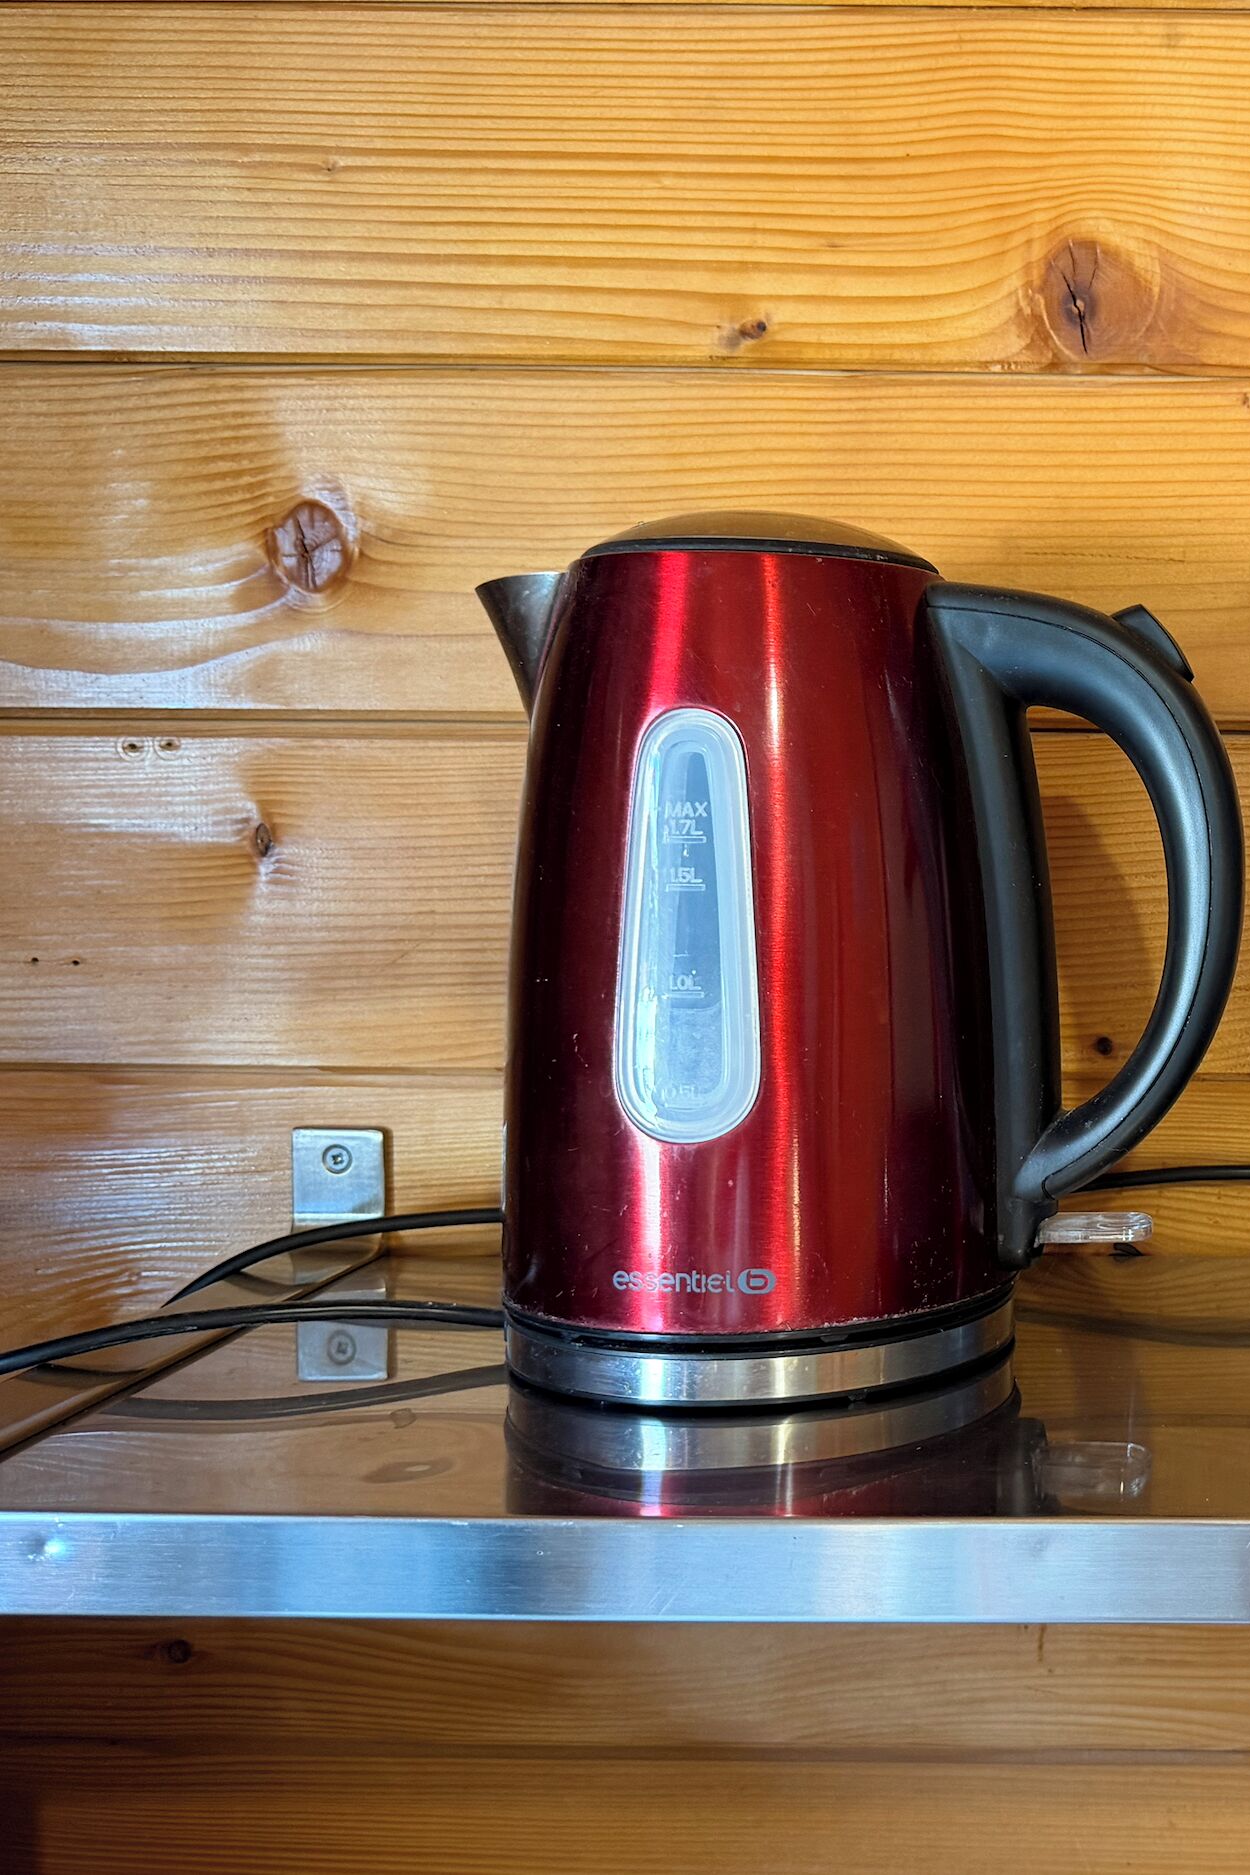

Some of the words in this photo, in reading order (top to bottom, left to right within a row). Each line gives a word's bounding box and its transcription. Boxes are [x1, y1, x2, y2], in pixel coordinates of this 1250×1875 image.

[664, 801, 708, 818] MAX
[669, 819, 704, 835] 1.7L
[670, 867, 703, 883] 1.5L
[612, 1270, 735, 1294] essentiel
